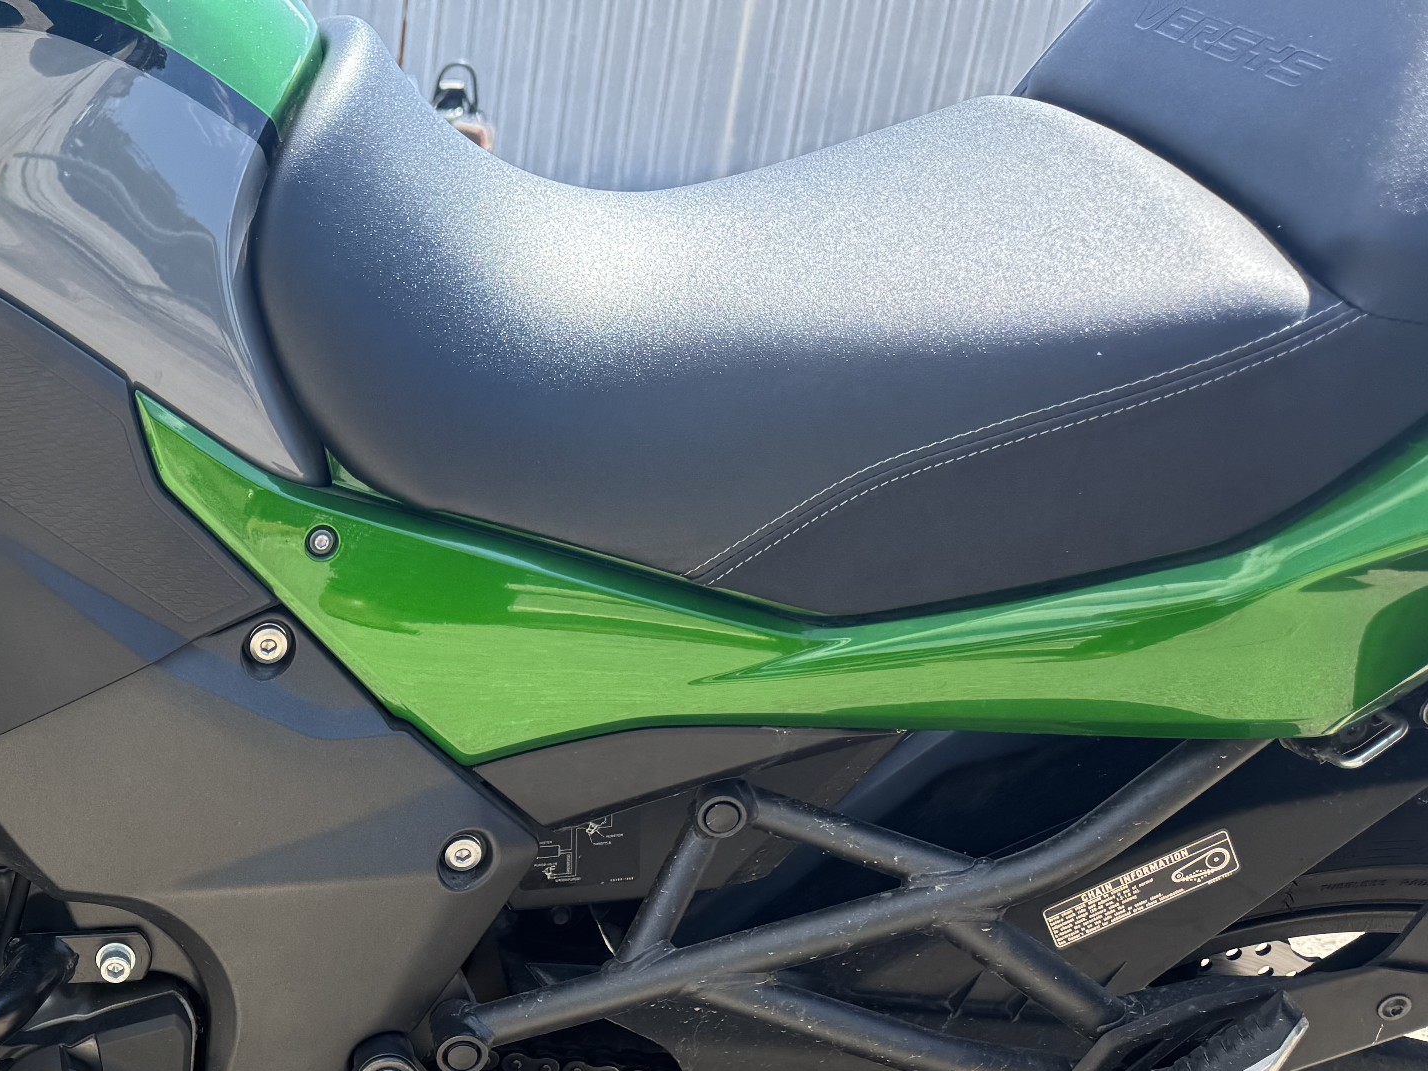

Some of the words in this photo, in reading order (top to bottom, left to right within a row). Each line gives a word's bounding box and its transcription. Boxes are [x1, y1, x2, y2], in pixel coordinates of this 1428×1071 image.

[1134, 0, 1333, 88] VERSYS
[1080, 882, 1113, 903] CHAIN
[1119, 848, 1190, 886] INFORMATION
